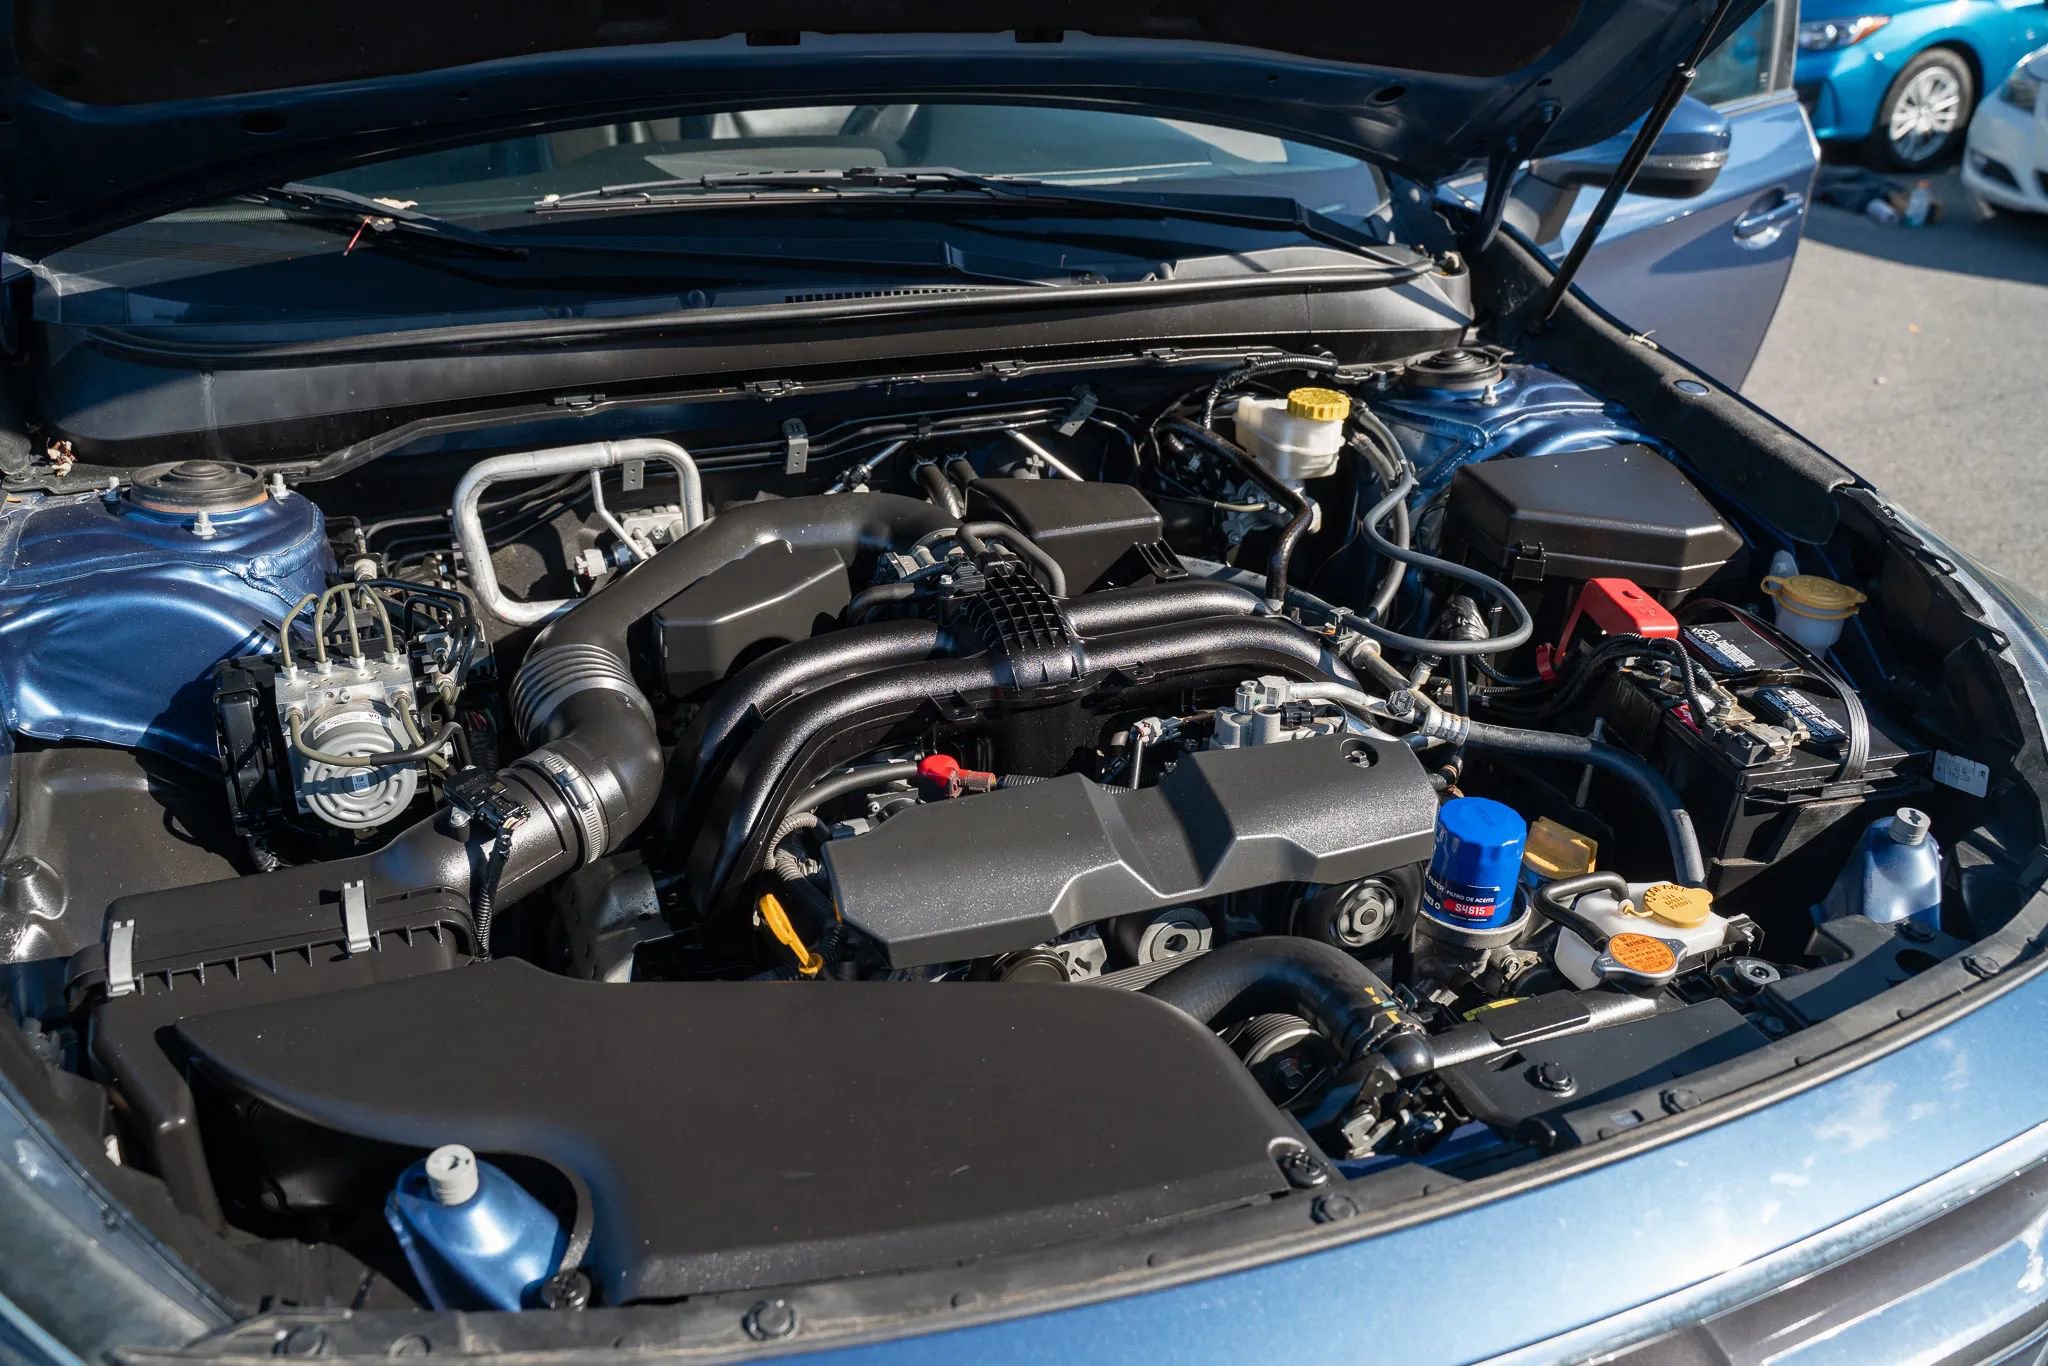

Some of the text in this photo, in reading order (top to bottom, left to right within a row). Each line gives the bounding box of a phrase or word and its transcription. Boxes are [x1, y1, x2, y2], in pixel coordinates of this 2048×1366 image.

[1428, 875, 1445, 892] FILTER
[1446, 890, 1465, 900] FILTRO
[1455, 903, 1486, 915] S4615
